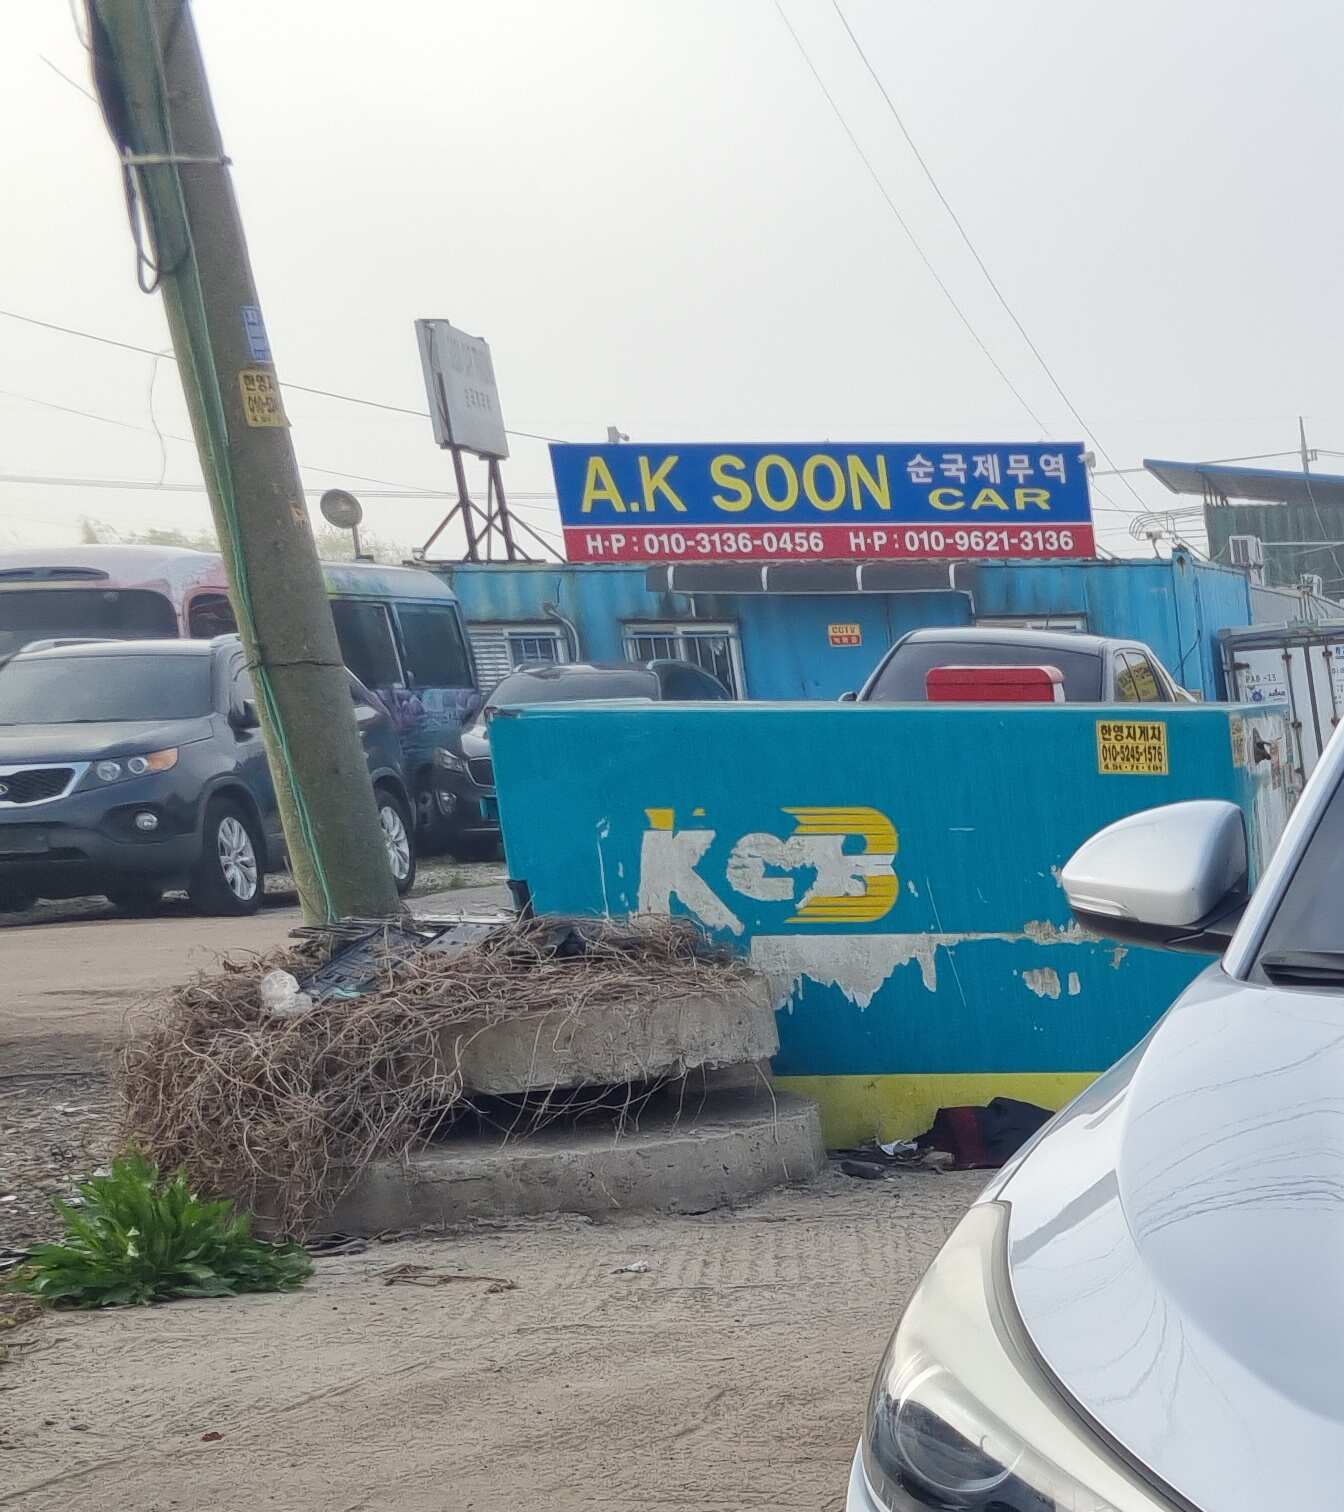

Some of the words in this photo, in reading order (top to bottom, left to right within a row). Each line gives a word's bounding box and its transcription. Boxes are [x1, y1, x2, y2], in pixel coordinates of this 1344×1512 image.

[906, 453, 1067, 485] 순국제무역
[581, 455, 688, 513] A.K
[709, 453, 892, 513] SOON
[928, 487, 1051, 511] CAR
[644, 532, 824, 554] 010-3136-0456
[904, 530, 1074, 552] 010-9621-3136
[1101, 724, 1162, 742] 한영지게차
[1102, 744, 1163, 763] 010-5245-1576
